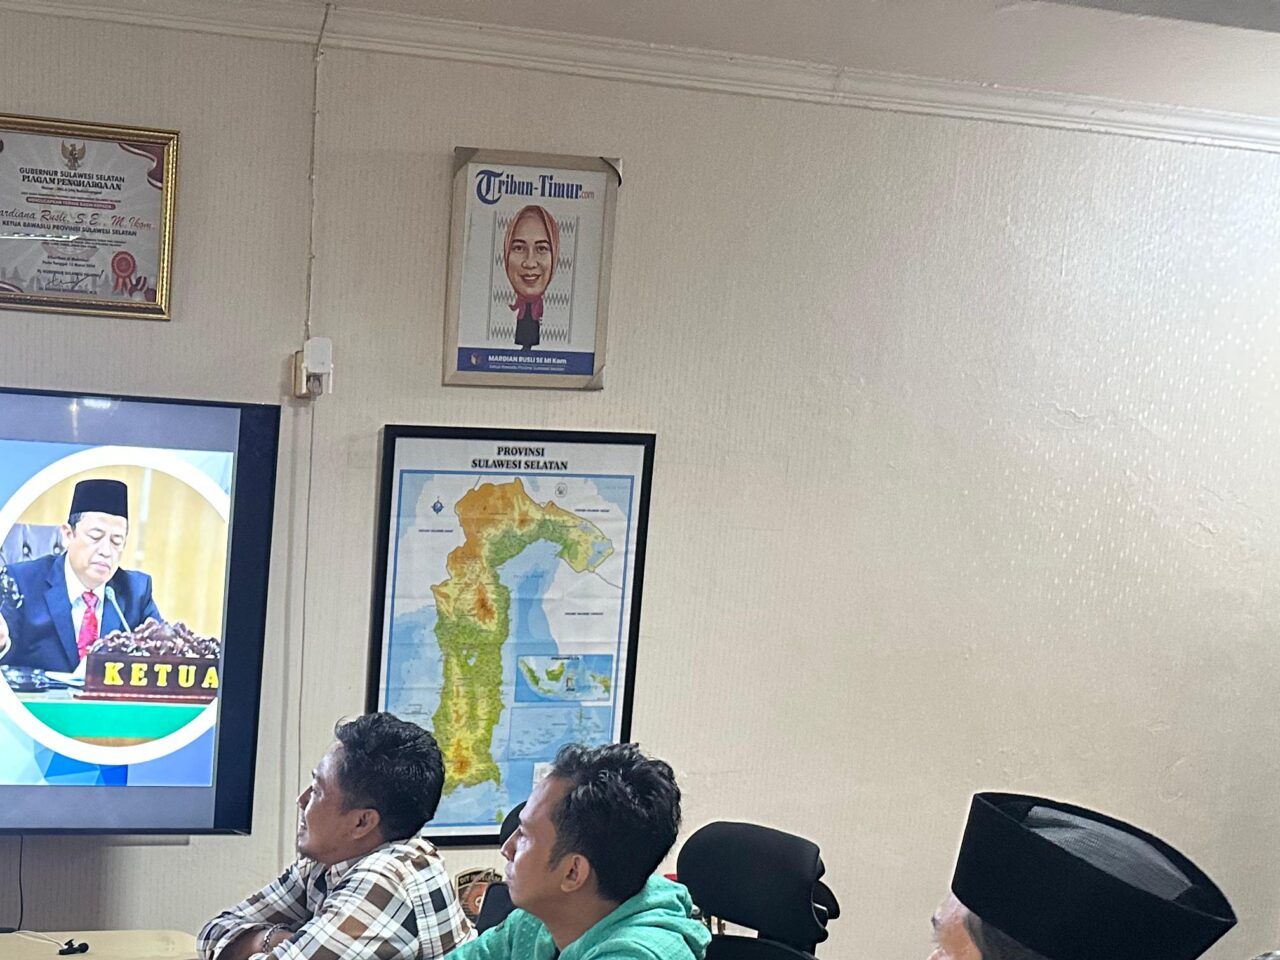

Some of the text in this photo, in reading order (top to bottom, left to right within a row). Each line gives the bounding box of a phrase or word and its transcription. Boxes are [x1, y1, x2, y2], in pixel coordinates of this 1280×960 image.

[19, 167, 125, 184] GUBERNUR SULAWESI SELATAN
[22, 175, 56, 185] PIAGAM
[57, 178, 121, 191] PENGHARGAAN
[23, 222, 51, 230] BAWASLU
[52, 224, 81, 232] PROVINSI
[82, 227, 110, 235] SULAWESI
[112, 229, 137, 237] SELATAN
[497, 446, 545, 457] PROVINSI
[471, 459, 568, 471] SULAWESI SELATAN
[103, 661, 219, 689] KETUA
